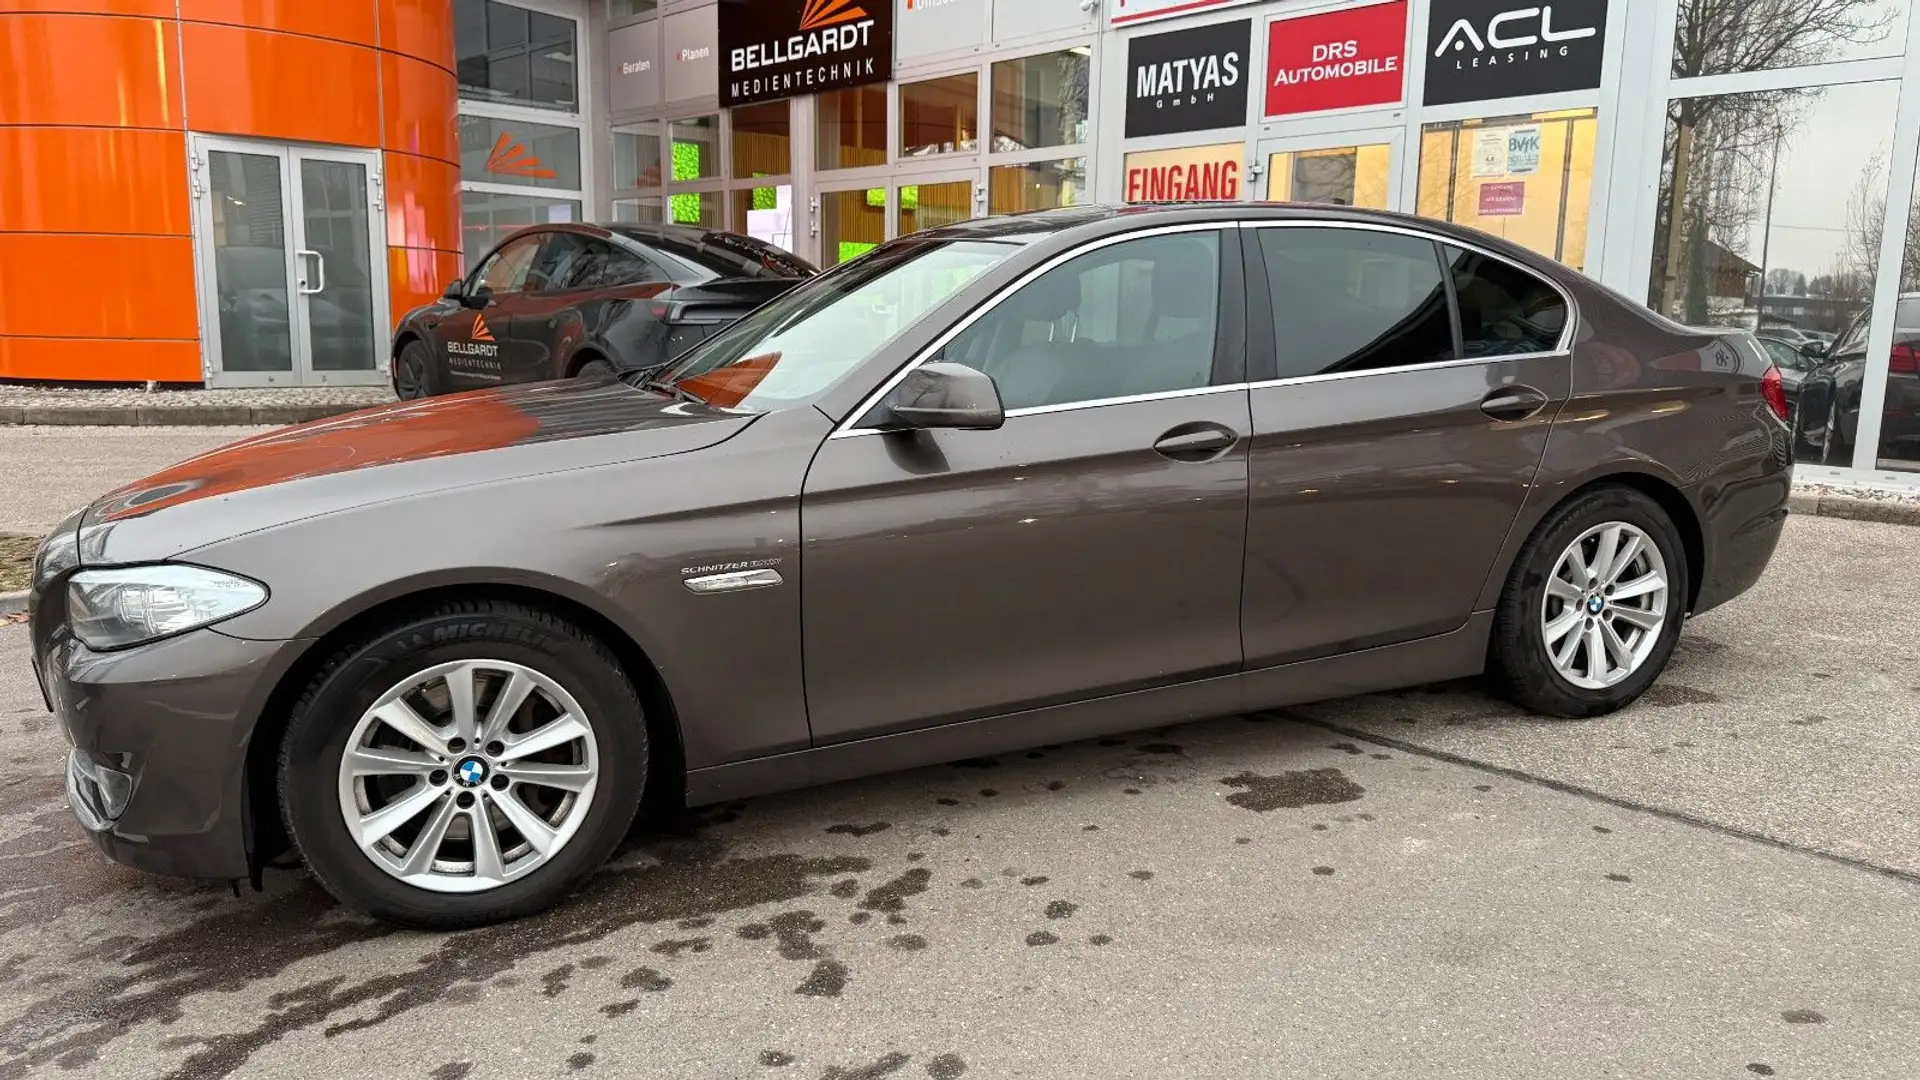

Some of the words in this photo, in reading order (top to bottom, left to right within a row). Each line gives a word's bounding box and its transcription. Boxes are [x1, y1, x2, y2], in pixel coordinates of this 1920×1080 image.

[1435, 5, 1597, 58] ACL
[681, 46, 710, 61] Planen
[731, 19, 875, 72] BELLGARDT
[1312, 40, 1358, 62] DRS
[622, 60, 651, 75] Beraten
[1456, 46, 1568, 70] LEASING
[731, 57, 875, 98] MEDIENTECHNIK
[1136, 51, 1239, 98] MATYAS
[1273, 56, 1398, 86] AUTOMOBILE
[447, 341, 498, 357] BELLGARDT
[681, 561, 749, 575] SCHNITZER
